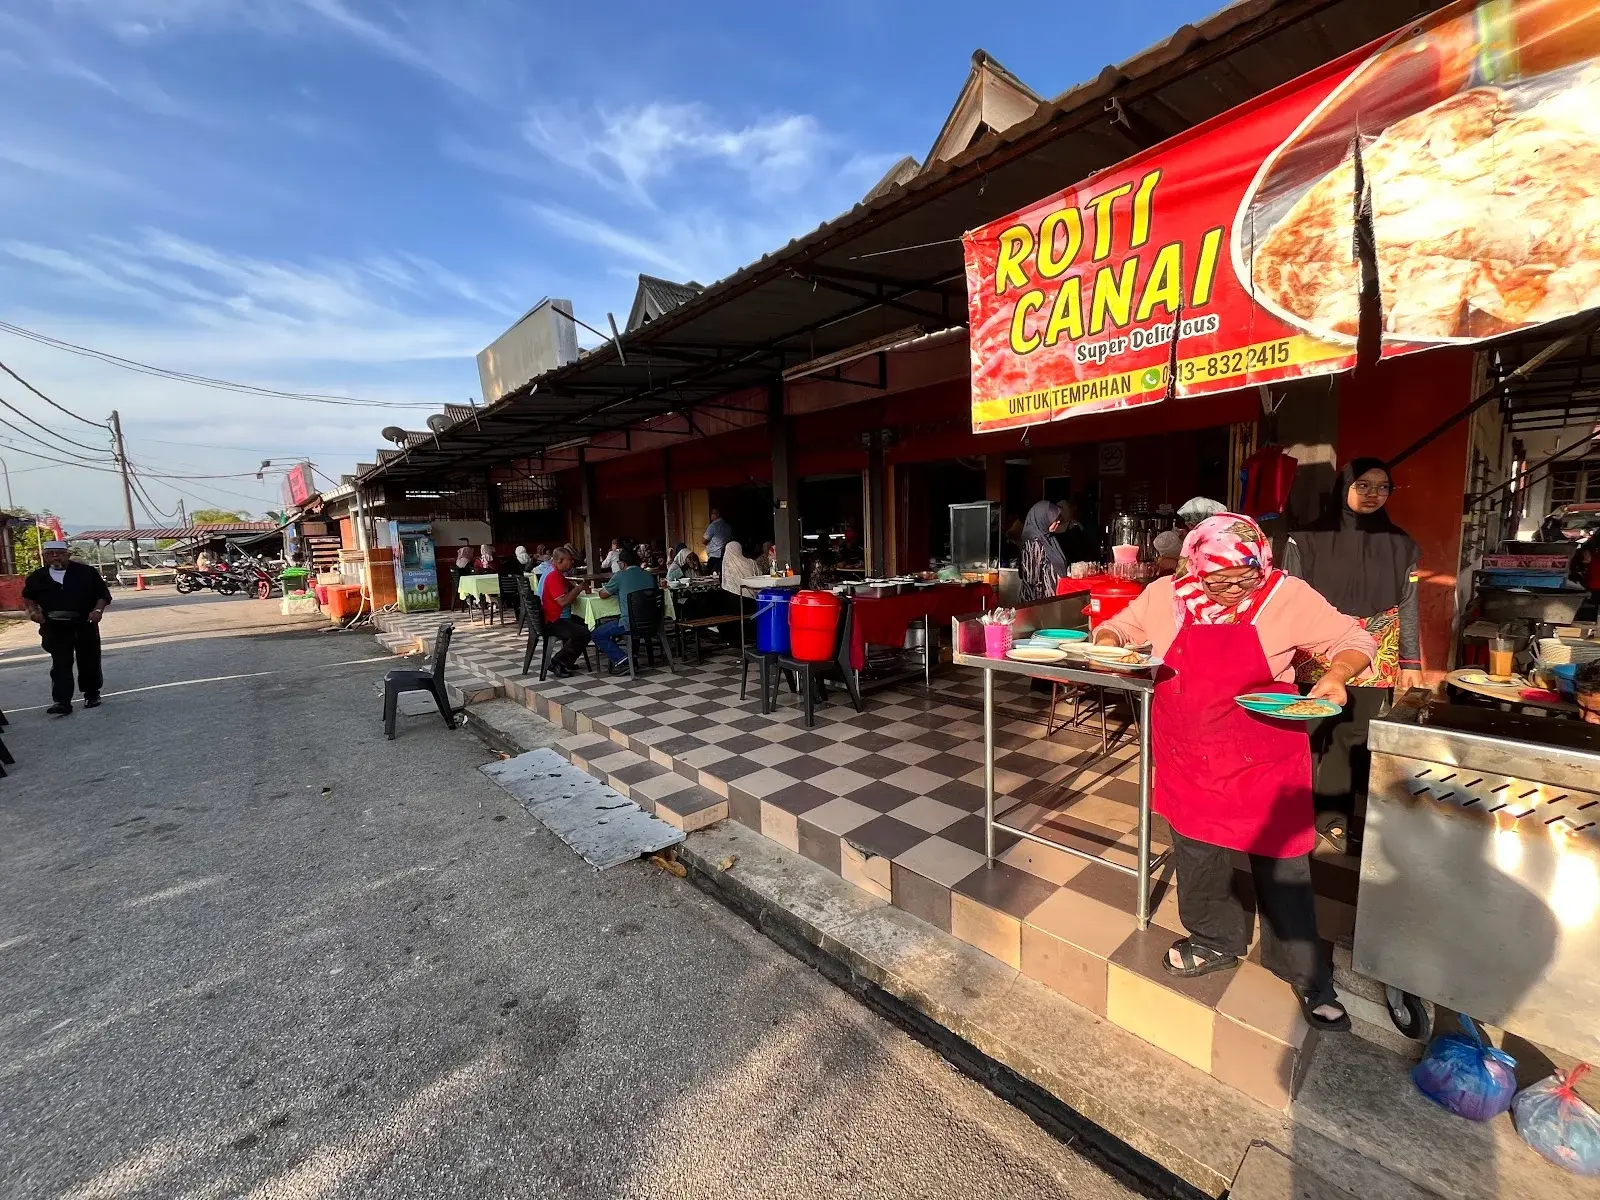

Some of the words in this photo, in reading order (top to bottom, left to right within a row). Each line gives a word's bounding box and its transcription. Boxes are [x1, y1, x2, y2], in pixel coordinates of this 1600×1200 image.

[995, 168, 1162, 295] ROTI
[1009, 226, 1223, 355] CANAI
[1077, 337, 1126, 362] Super
[1009, 391, 1049, 414] UNTUK
[1052, 375, 1131, 406] TEMPAHAN
